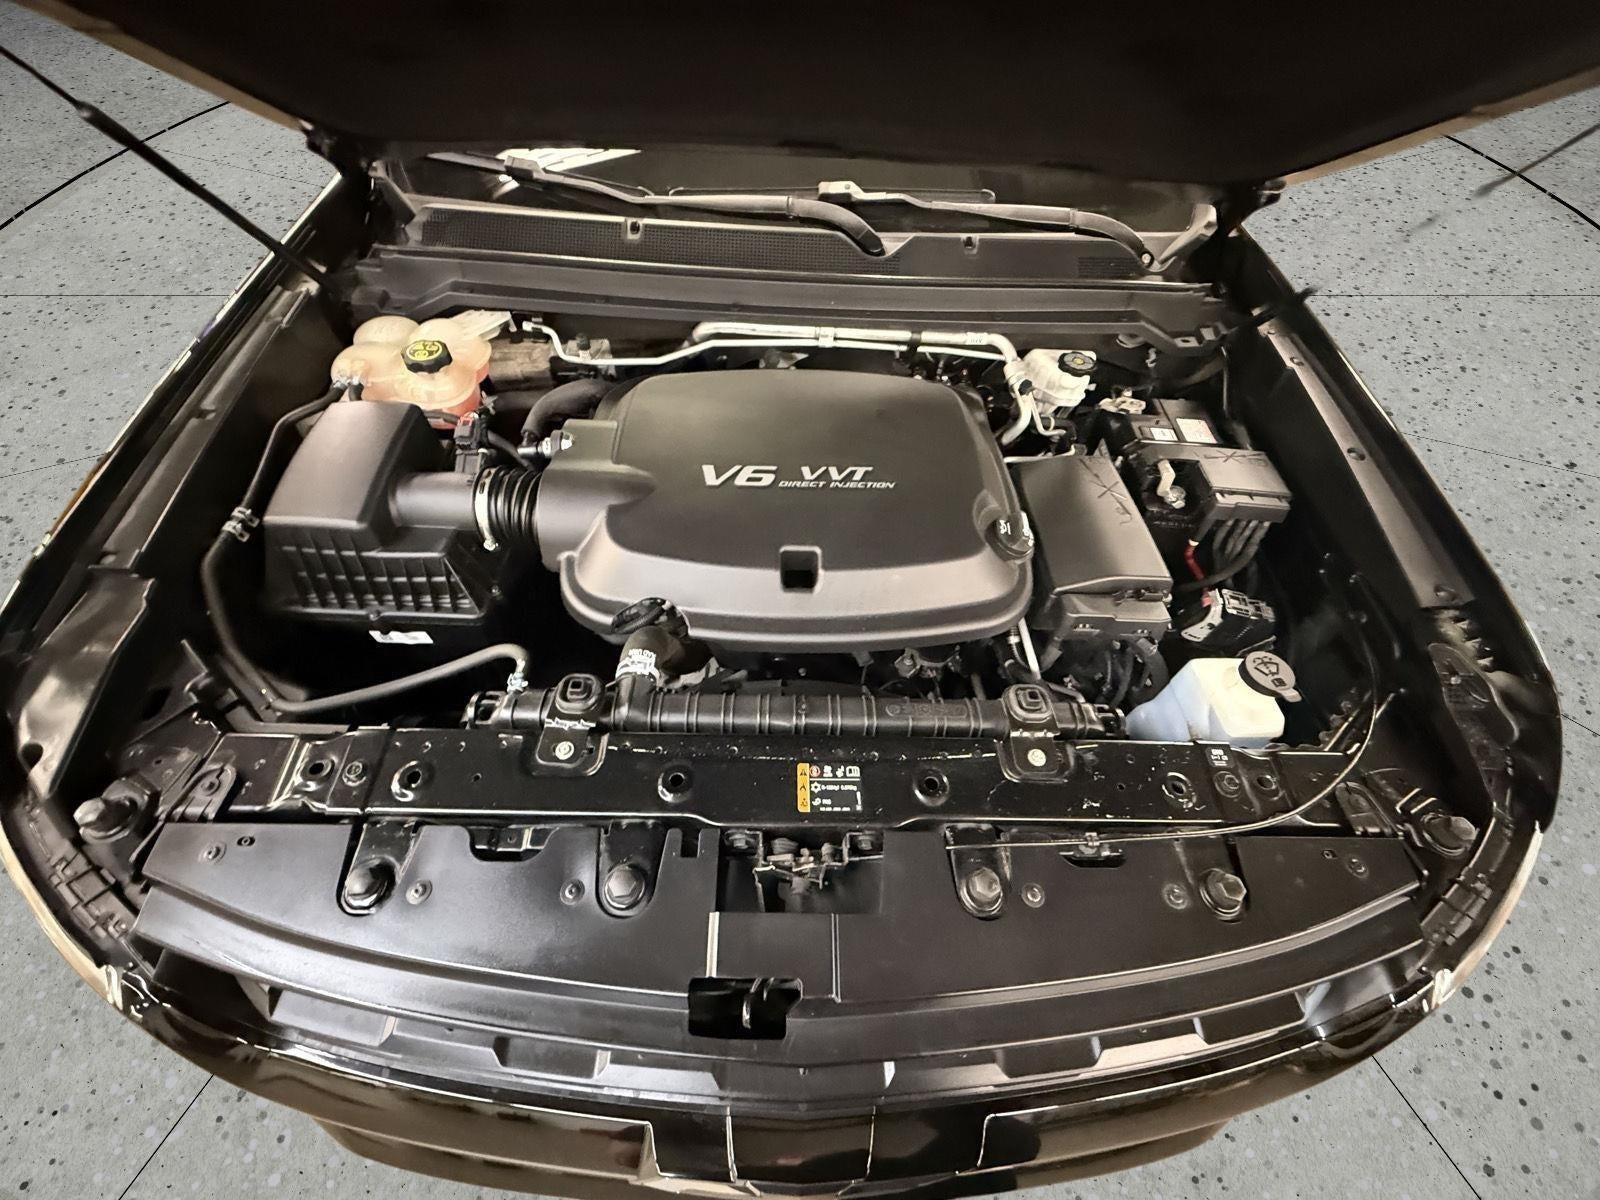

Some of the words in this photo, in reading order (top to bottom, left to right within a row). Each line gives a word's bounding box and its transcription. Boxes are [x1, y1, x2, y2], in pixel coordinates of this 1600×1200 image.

[701, 464, 778, 487] V6
[800, 466, 873, 481] VVT
[829, 481, 896, 489] INJECTION
